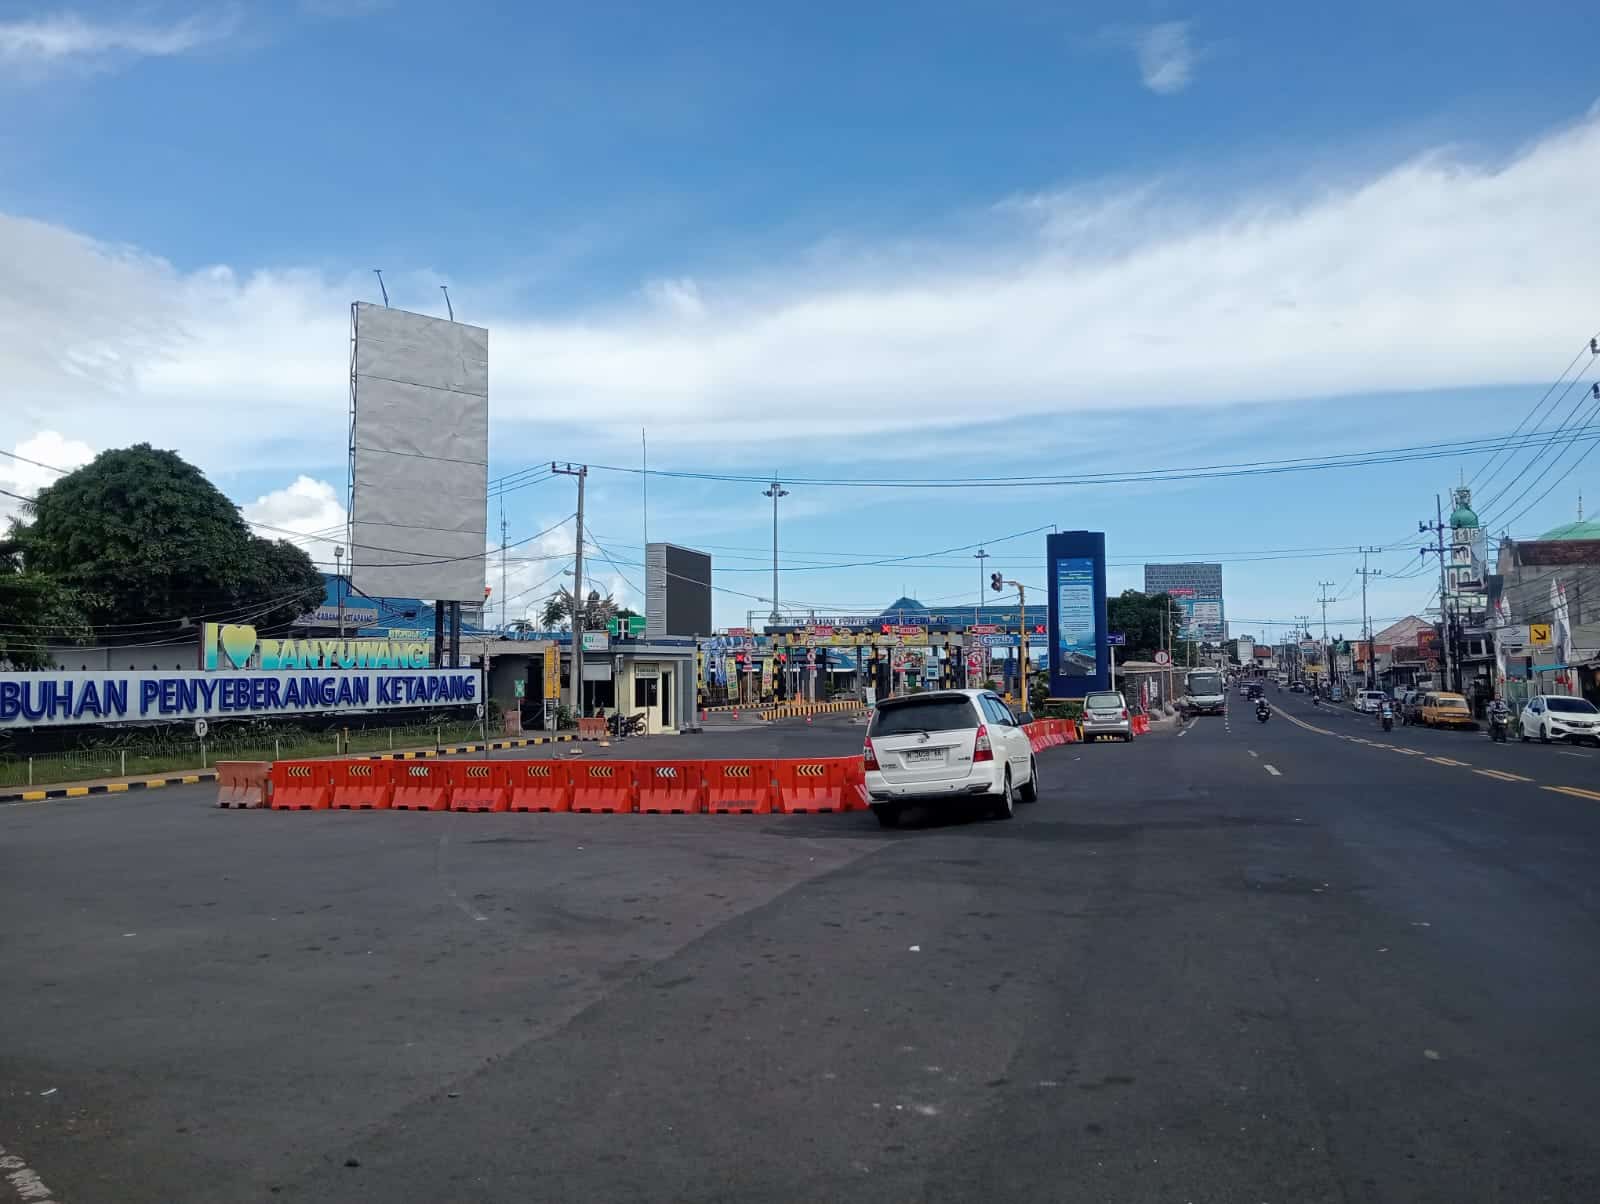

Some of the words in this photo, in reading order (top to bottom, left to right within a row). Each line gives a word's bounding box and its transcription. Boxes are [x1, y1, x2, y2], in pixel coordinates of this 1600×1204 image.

[260, 639, 431, 670] BANYUWANGI
[0, 679, 128, 720] BUHAN
[140, 676, 369, 715] PENYEBERANGAN
[376, 675, 476, 704] KETAPANG
